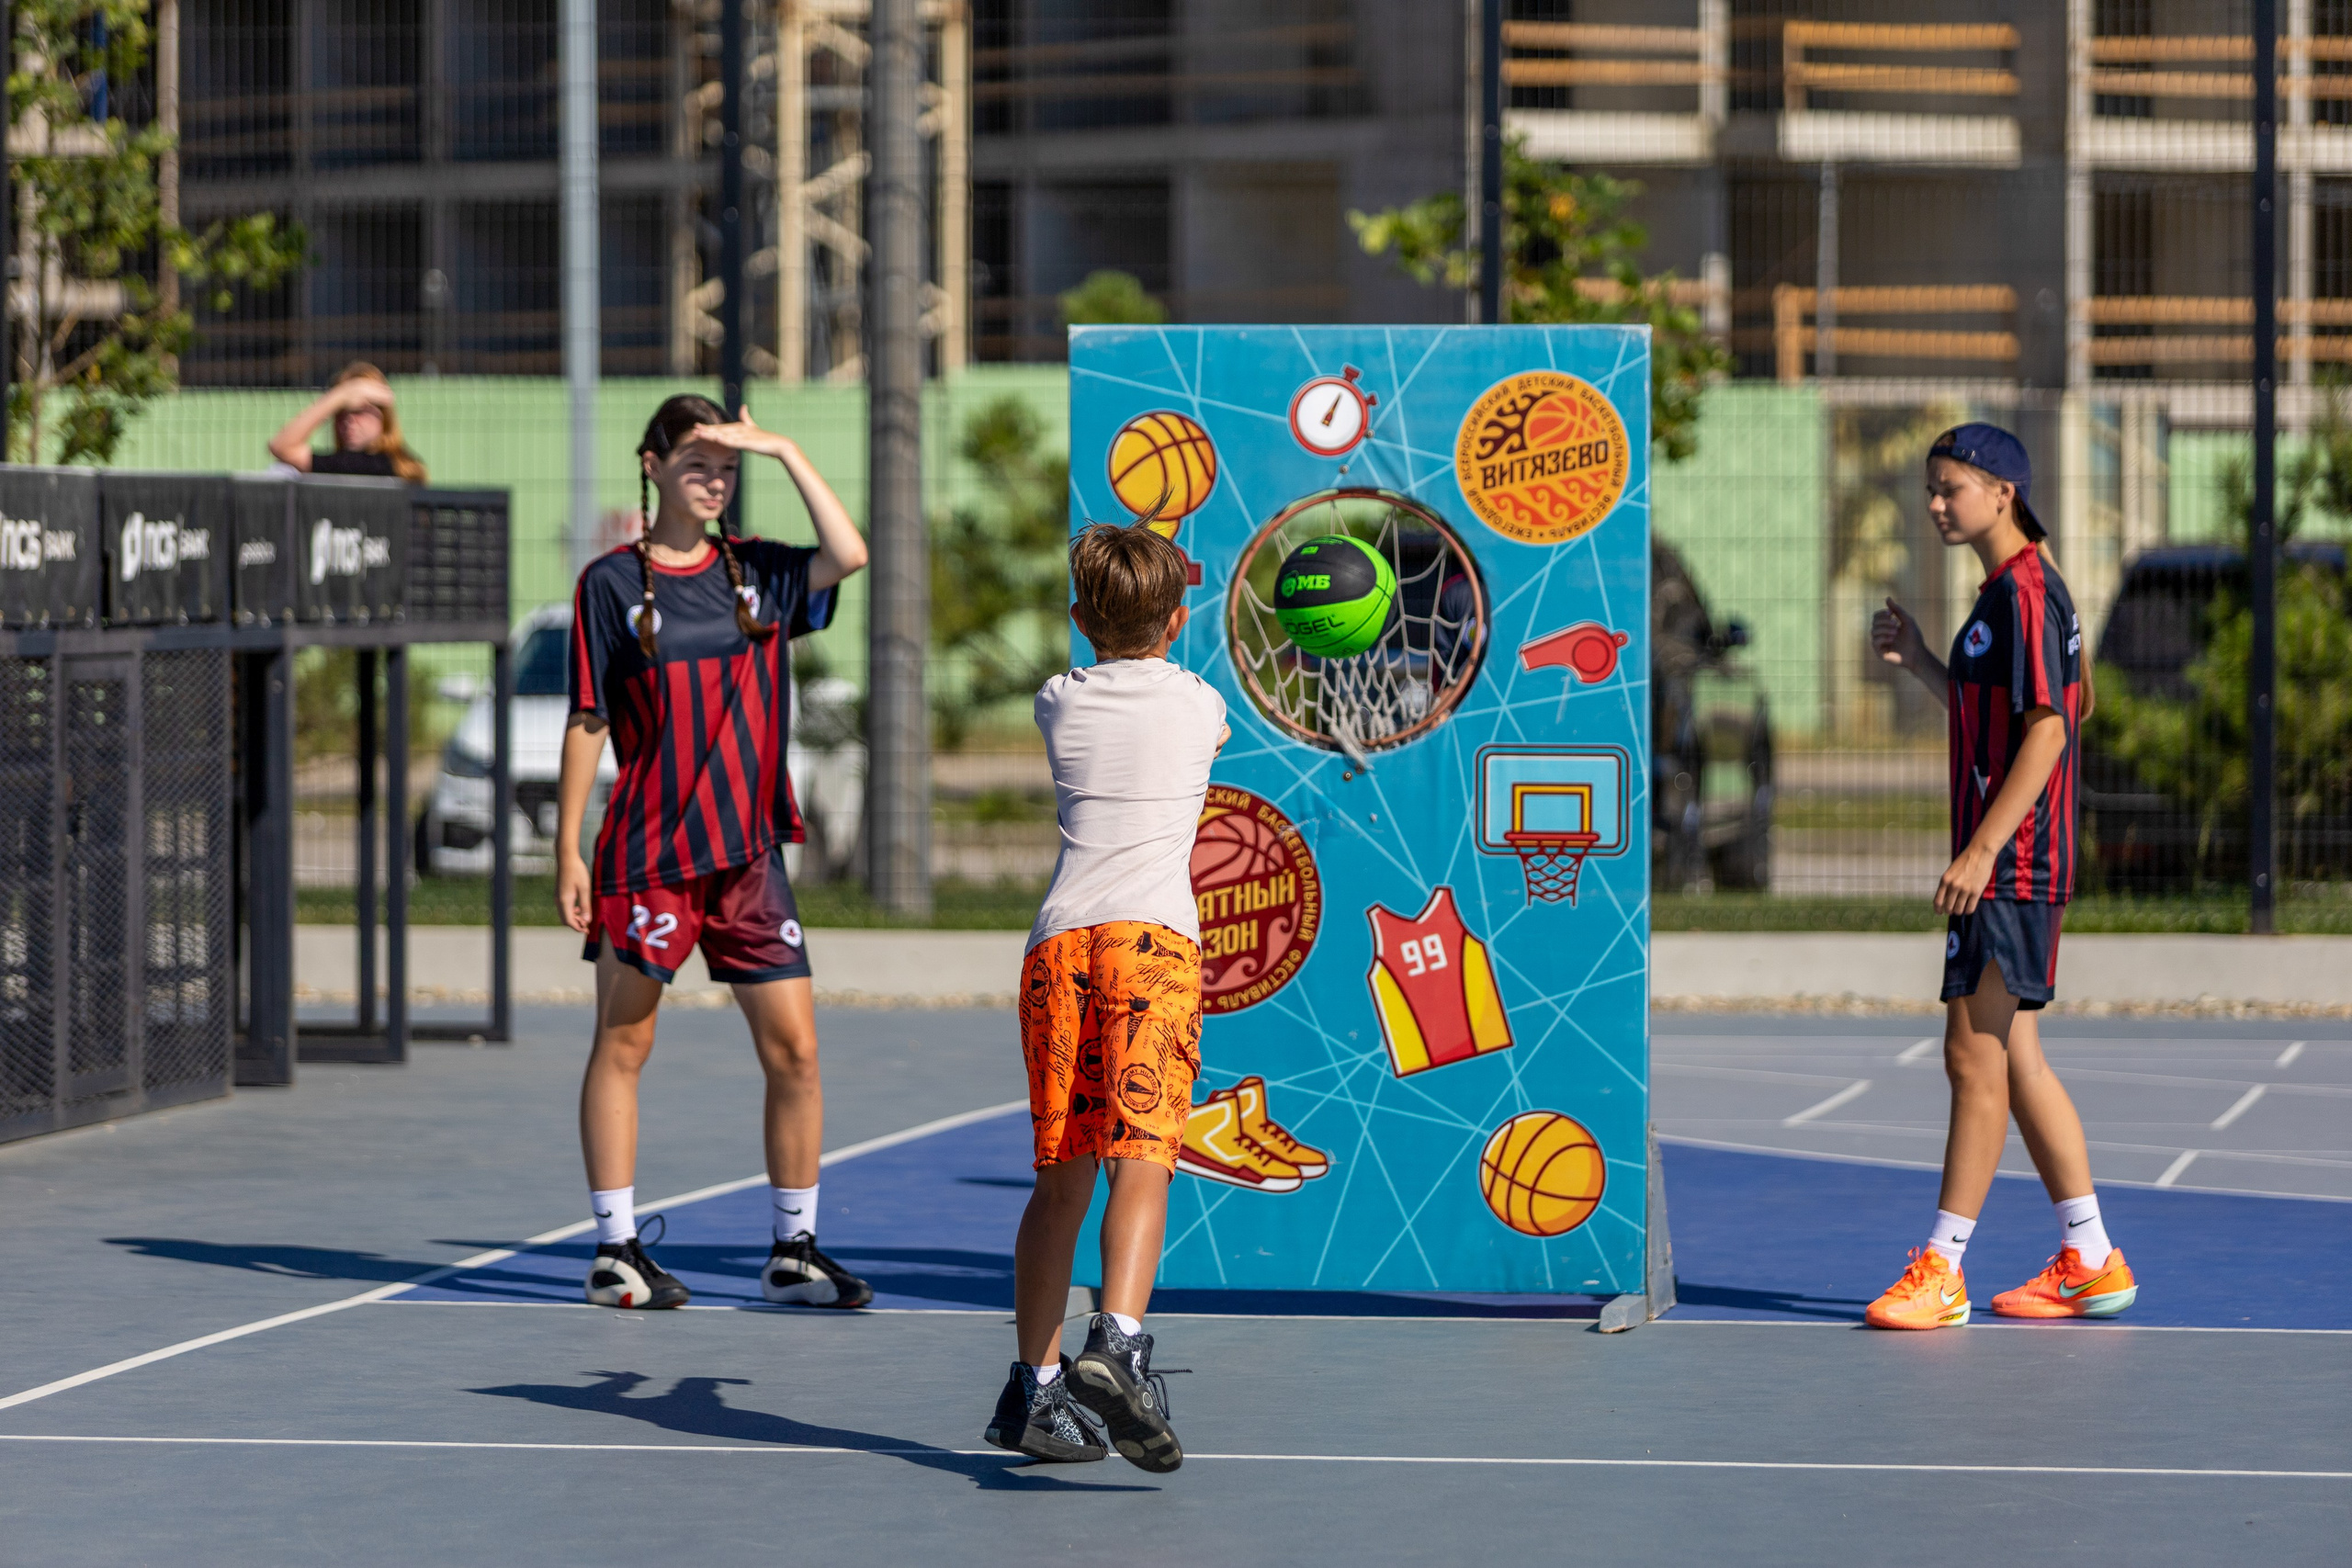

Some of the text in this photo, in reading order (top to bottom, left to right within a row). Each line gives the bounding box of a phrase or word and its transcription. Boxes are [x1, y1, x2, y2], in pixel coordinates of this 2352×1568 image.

[1460, 376, 1624, 538] ВСЕРОССИЙСКИЙ ДЕТСКИЙ БАСКЕТБОЛЬНЫЙ ФЕСТИВАЛЬ ЕЖЕГОДНЫЙ
[1479, 439, 1609, 491] ВИТЯЗЕВО
[1204, 787, 1251, 812] СКИЙ
[1196, 868, 1296, 923] АТНЫЙ
[626, 904, 678, 950] 22
[1400, 933, 1448, 976] 99
[1125, 964, 1190, 995] Hilfiger
[1216, 948, 1302, 1010] ФЕСТИВАЛЬ
[1122, 1068, 1138, 1085] TOMMY
[1130, 1127, 1150, 1140] 1985
